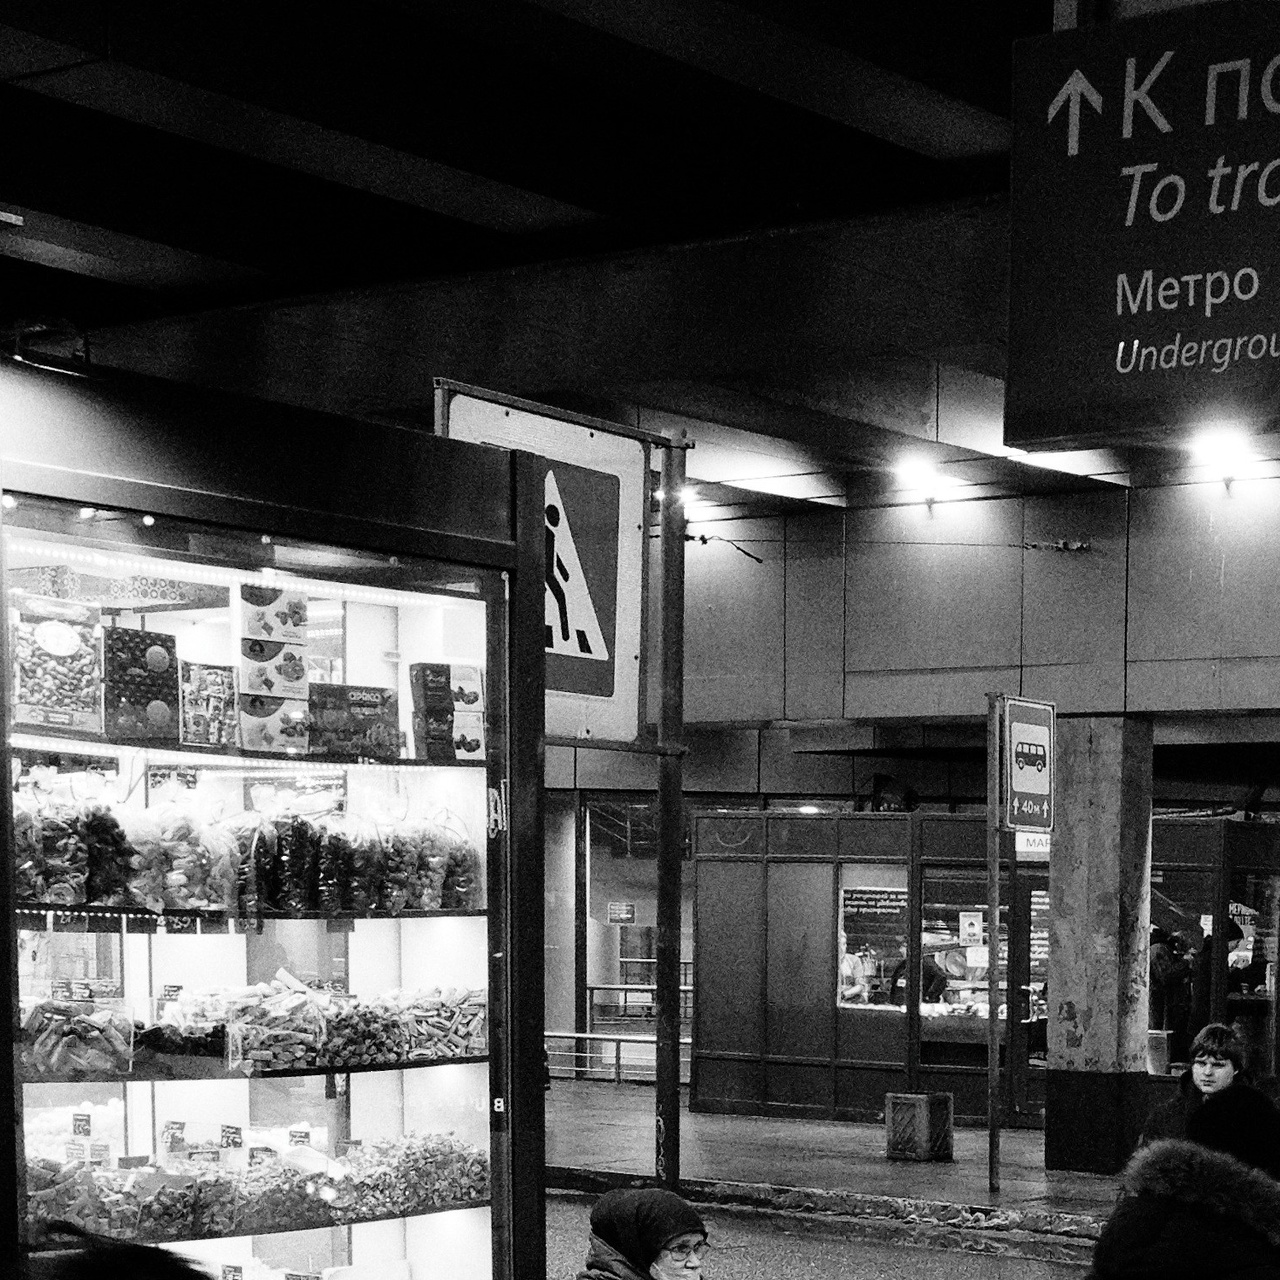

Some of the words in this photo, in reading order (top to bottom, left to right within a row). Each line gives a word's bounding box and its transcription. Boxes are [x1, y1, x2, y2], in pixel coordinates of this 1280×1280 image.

[1122, 50, 1175, 139] К
[1120, 162, 1186, 227] To
[1116, 266, 1260, 318] Метро
